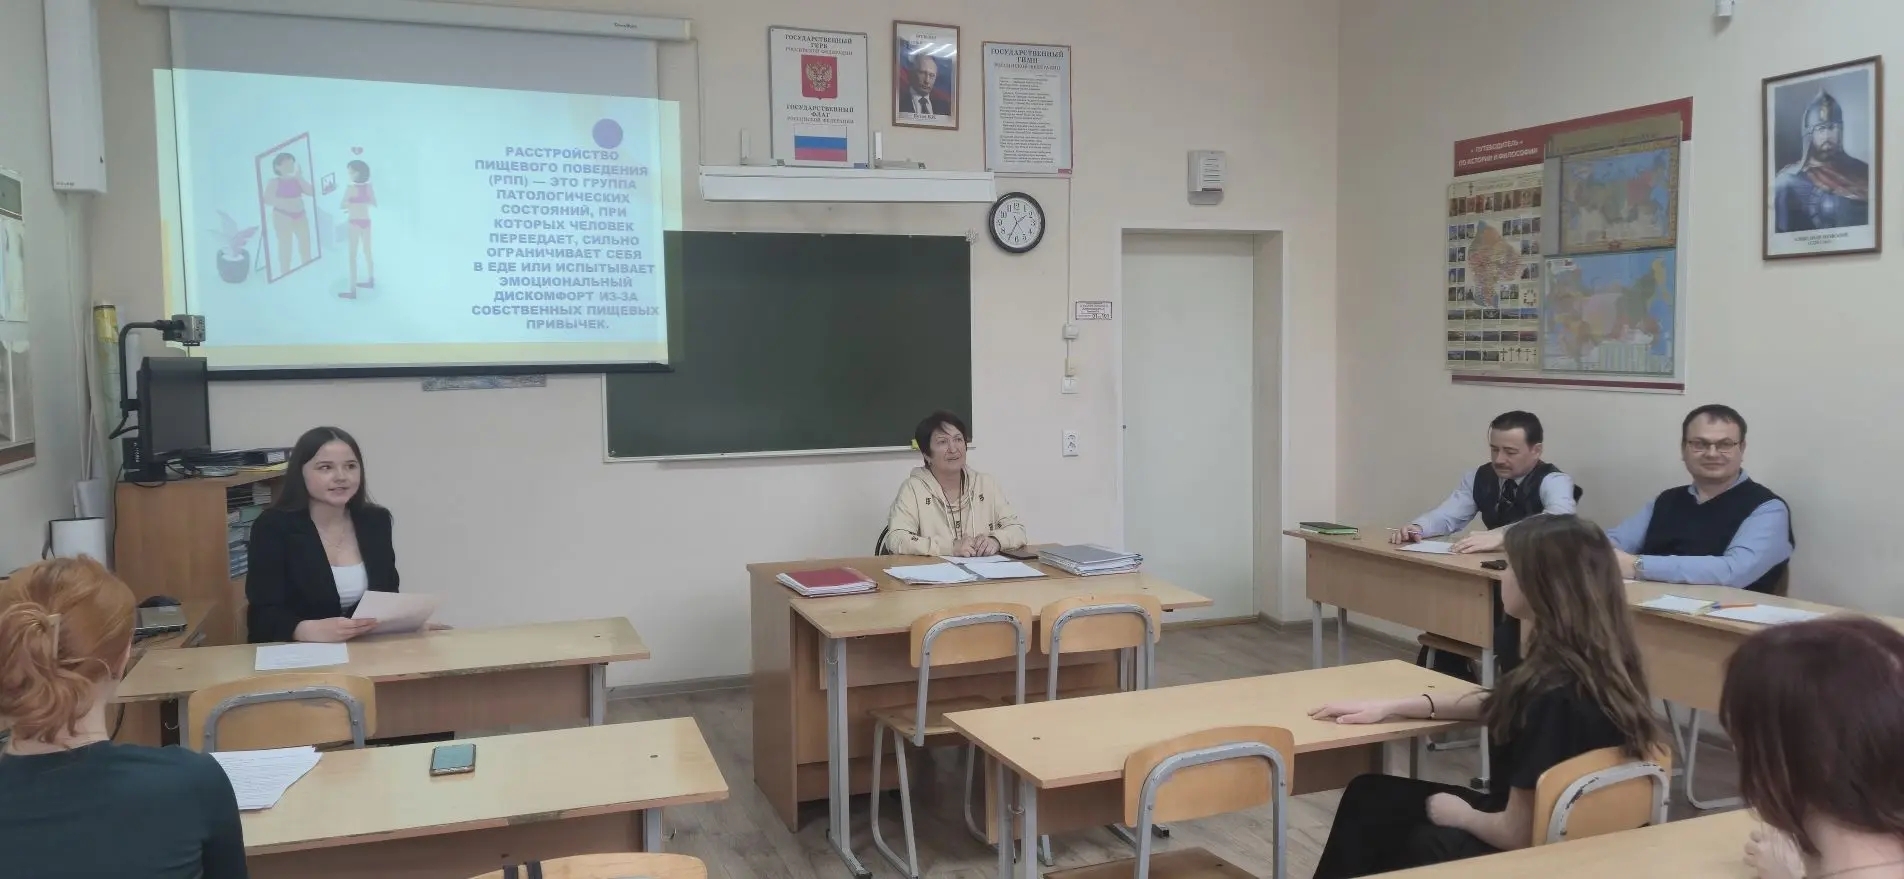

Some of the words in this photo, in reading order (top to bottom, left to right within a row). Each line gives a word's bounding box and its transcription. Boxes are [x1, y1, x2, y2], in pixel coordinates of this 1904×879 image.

[785, 34, 852, 44] ГОСУДАРСТВЕННЫЙ
[991, 48, 1064, 57] ГОСУДАРСТВЕННЫЙ
[786, 104, 854, 112] ГОСУДАРСТВЕННЫЙ
[1476, 140, 1518, 152] ПУТЕВОДИТЕЛЬ
[506, 147, 619, 160] РАССТРОЙСТВО
[475, 160, 558, 172] ПИЩЕВОГО
[563, 163, 648, 176] ПОВЕДЕНИЯ
[488, 174, 528, 187] (РПП)
[550, 177, 578, 187] ЭТО
[583, 178, 637, 189] ГРУППА
[496, 189, 630, 203] ПАТОЛОГИЧЕСКИХ
[501, 204, 594, 218] СОСТОЯНИЙ,
[599, 207, 627, 217] ПРИ
[494, 219, 565, 230] КОТОРЫХ
[570, 220, 634, 232] ЧЕЛОВЕК
[489, 233, 578, 246] ПЕРЕЕДАЕТ,
[582, 235, 640, 246] СИЛЬНО
[487, 248, 601, 258] ОГРАНИЧИВАЕТ
[606, 250, 642, 259] СЕБЯ
[474, 262, 483, 272] В
[488, 262, 516, 274] ЕДЕ
[521, 263, 551, 272] ИЛИ
[556, 263, 655, 274] ИСПЫТЫВАЕТ
[500, 276, 632, 289] ЭМОЦИОНАЛЬНЫЙ
[494, 291, 594, 302] ДИСКОМФОРТ
[599, 292, 638, 301] ИЗ-ЗА
[472, 305, 582, 316] СОБСТВЕННЫХ
[587, 305, 659, 317] ПИЩЕВЫХ
[526, 320, 609, 330] ПРИВЫЧЕК.
